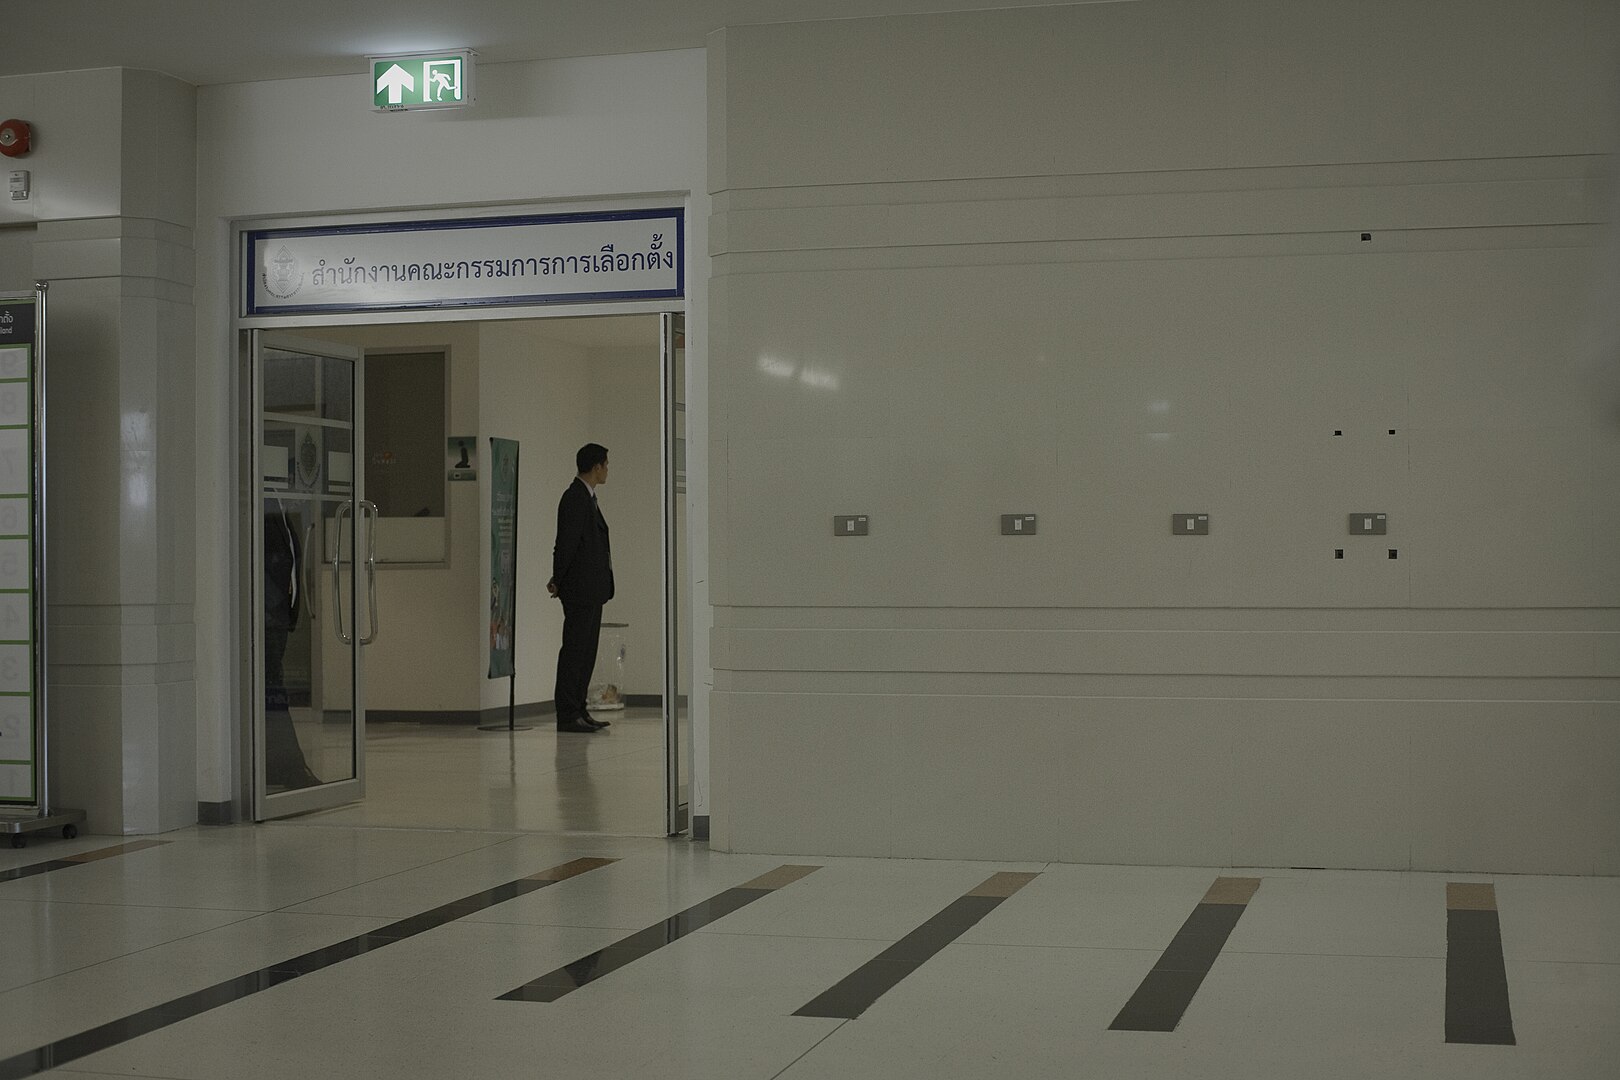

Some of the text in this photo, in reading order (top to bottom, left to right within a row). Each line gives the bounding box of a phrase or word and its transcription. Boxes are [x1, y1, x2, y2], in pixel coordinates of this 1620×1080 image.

[311, 233, 674, 286] สำนักงานคณะกรรมการการเลือกตั้ง
